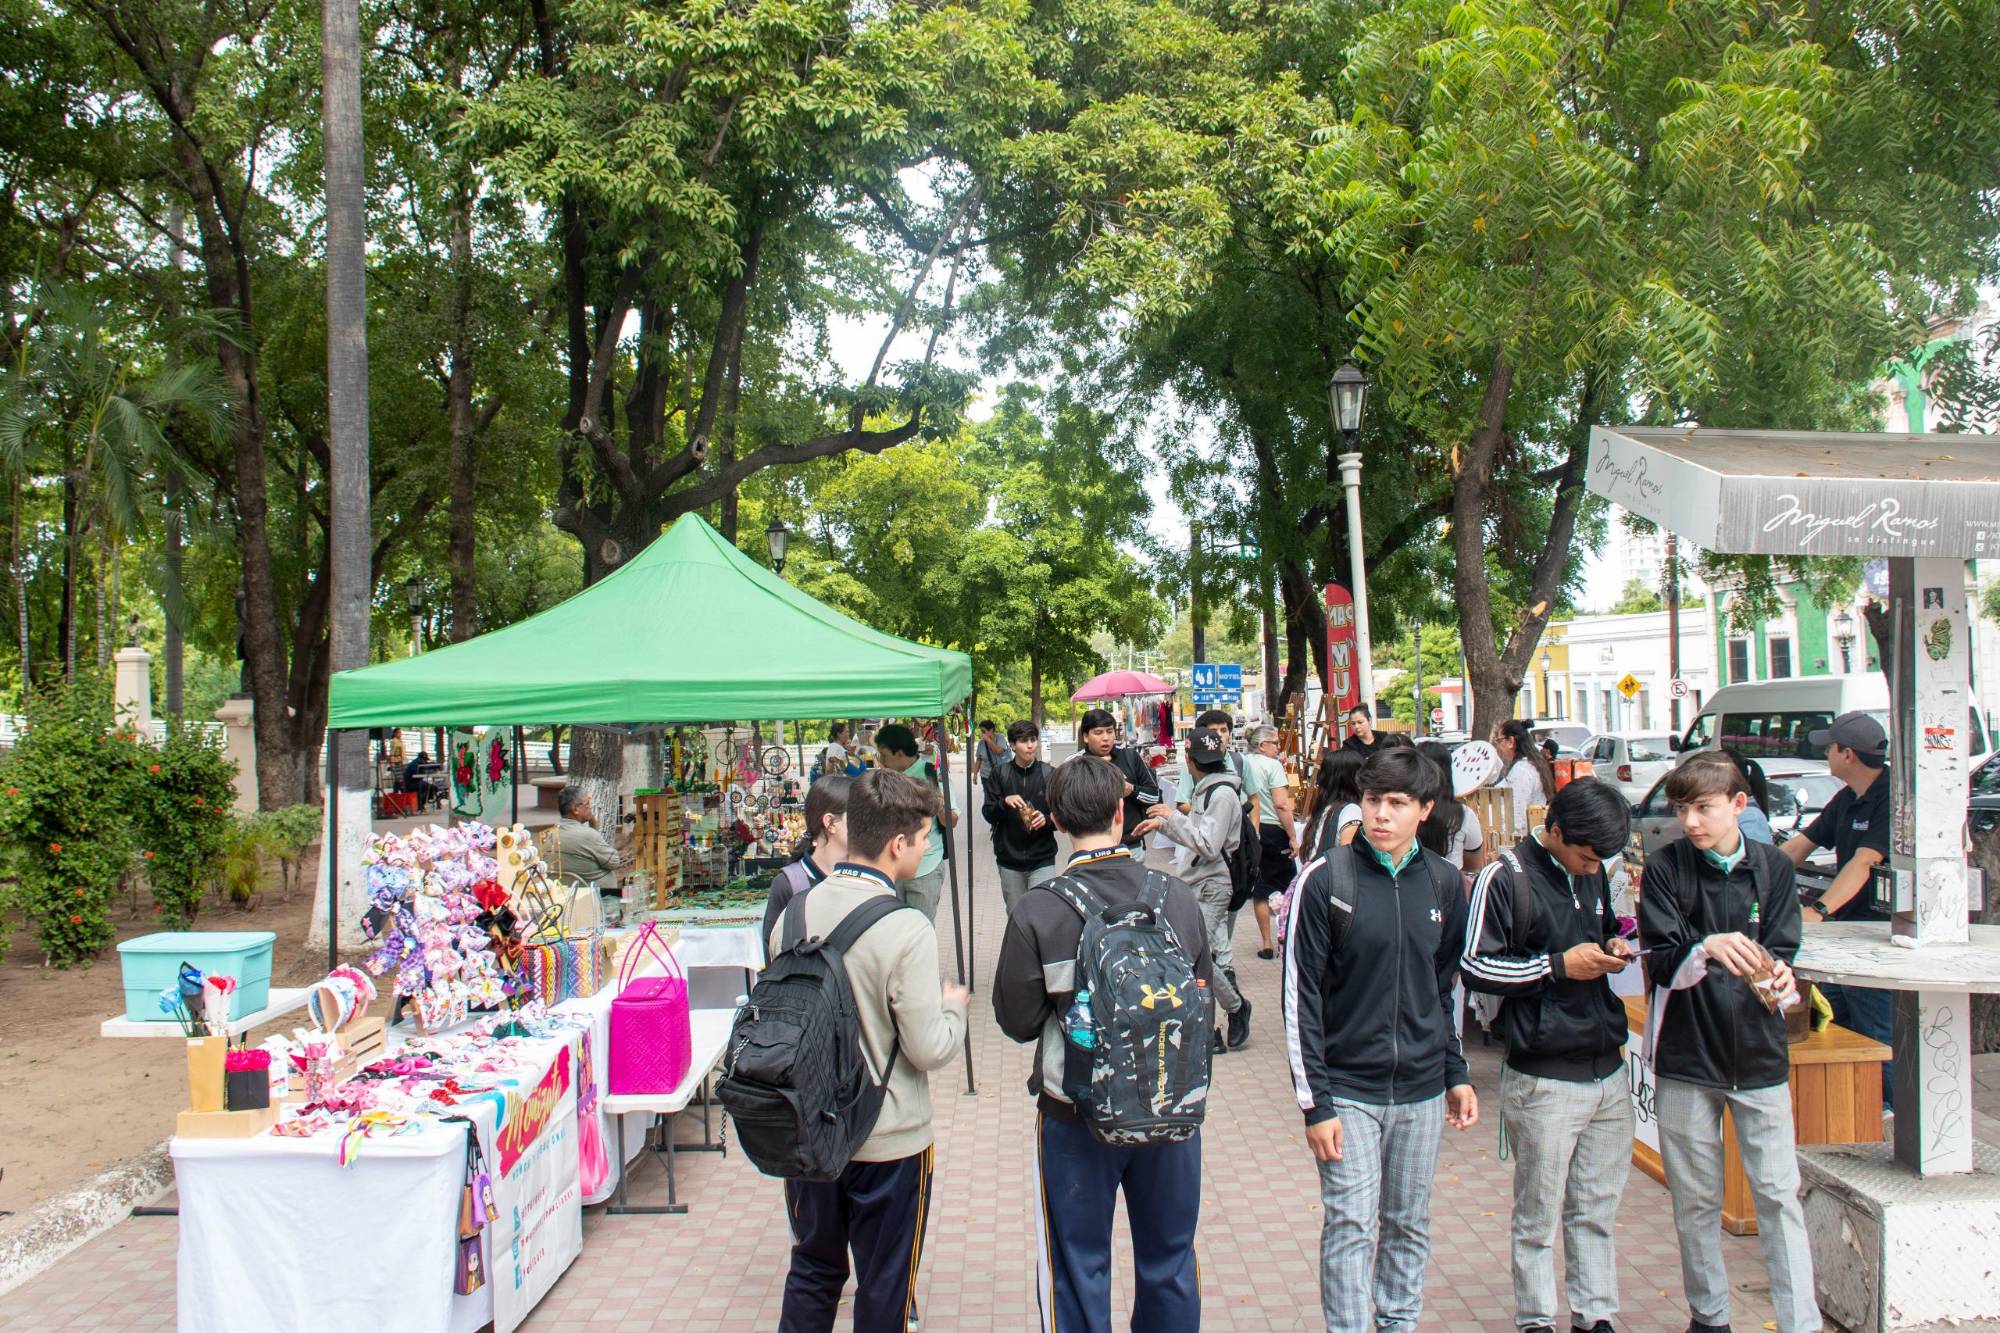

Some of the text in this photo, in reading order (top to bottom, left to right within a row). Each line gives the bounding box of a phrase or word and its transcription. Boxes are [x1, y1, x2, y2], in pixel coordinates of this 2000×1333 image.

[1763, 494, 1938, 546] Miguel Ramos
[1848, 533, 1936, 547] se distingue
